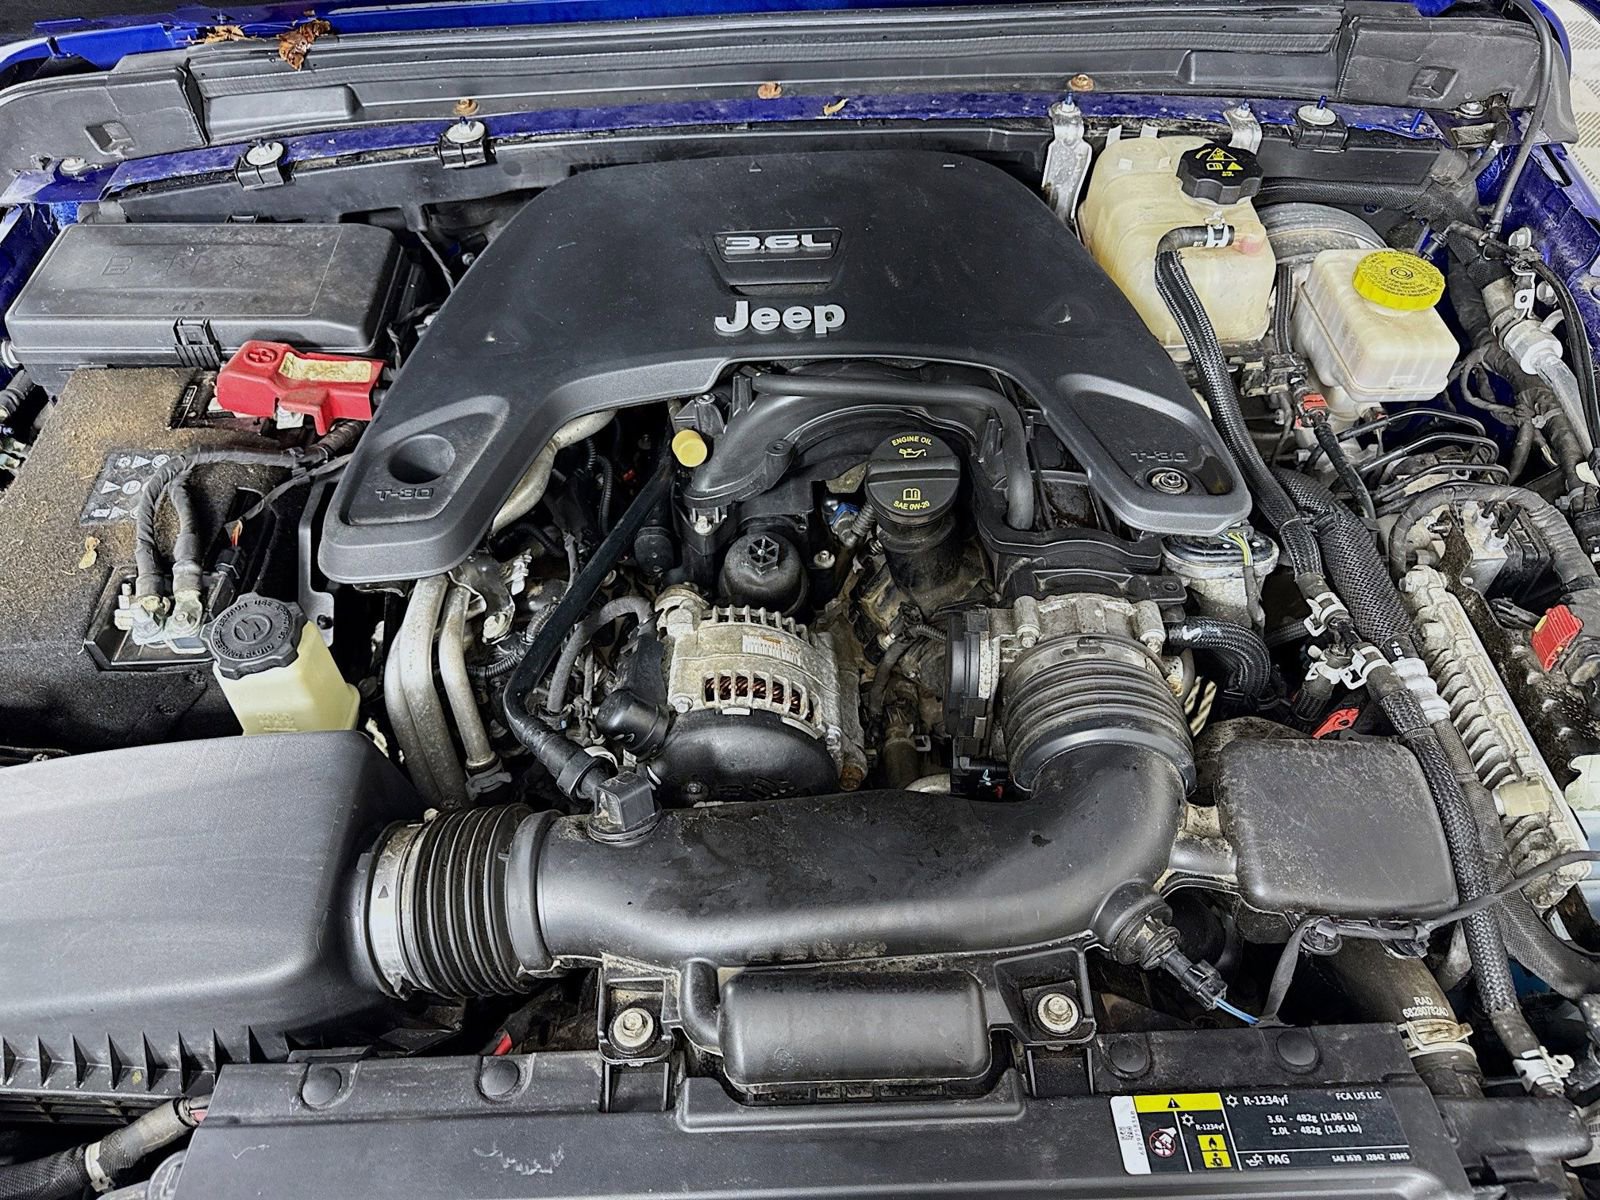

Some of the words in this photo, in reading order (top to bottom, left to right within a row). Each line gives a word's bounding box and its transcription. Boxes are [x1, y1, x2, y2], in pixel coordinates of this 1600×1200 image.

[725, 233, 832, 255] 3.6L
[714, 300, 846, 338] Jeep
[891, 435, 920, 447] ENGINE
[920, 436, 933, 446] OIL
[375, 487, 434, 502] T-30
[893, 500, 908, 510] SAE
[909, 500, 930, 511] 0W-20
[1413, 996, 1433, 1006] RAD
[1243, 1094, 1289, 1106] R-1234yf
[1335, 1092, 1353, 1101] FCA
[1354, 1091, 1366, 1100] US
[1366, 1091, 1382, 1100] LLC
[1267, 1115, 1286, 1123] 3.6L
[1296, 1113, 1318, 1124] 482g
[1320, 1112, 1343, 1123] (1.06
[1343, 1111, 1358, 1122] Lb)
[1195, 1123, 1225, 1131] R-1234yf
[1271, 1127, 1290, 1136] 2.0L
[1300, 1125, 1322, 1136] 482g
[1324, 1124, 1347, 1135] (1.06
[1347, 1123, 1362, 1134] Lb)
[1267, 1154, 1290, 1164] PAG
